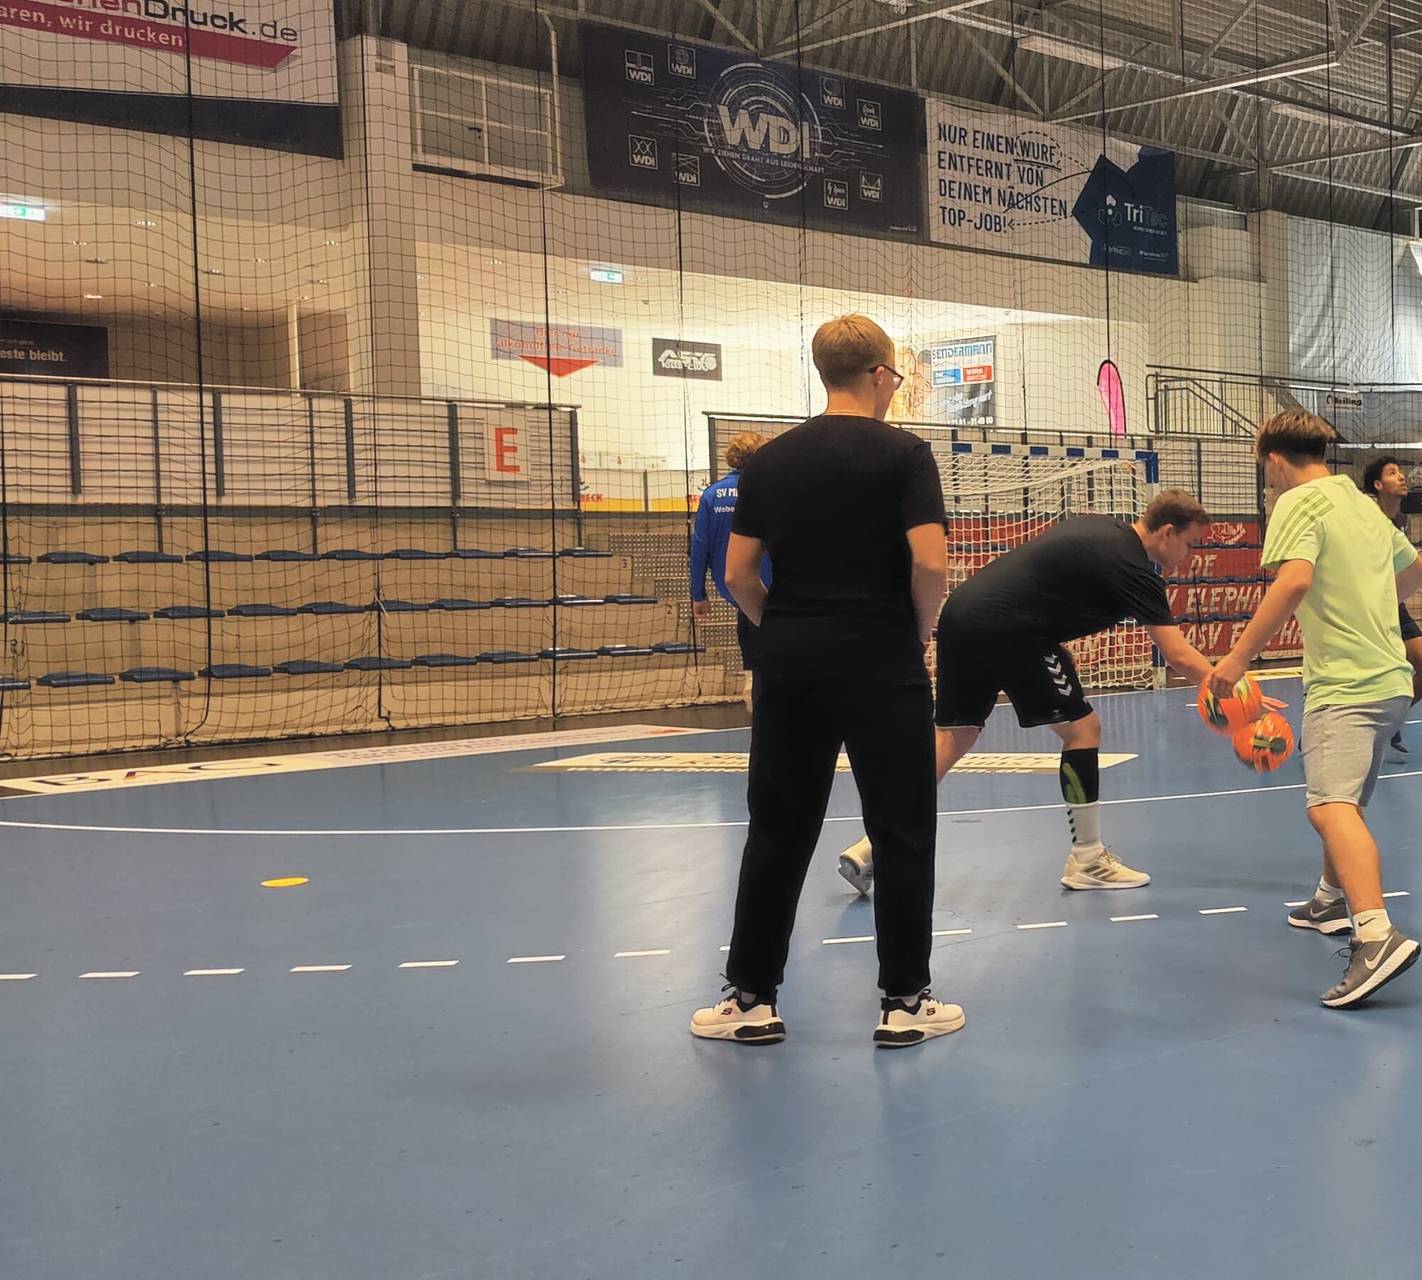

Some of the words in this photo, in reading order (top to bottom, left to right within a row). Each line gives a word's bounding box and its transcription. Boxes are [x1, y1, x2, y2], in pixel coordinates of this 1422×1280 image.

[60, 15, 93, 32] wir
[100, 19, 184, 48] drucken
[717, 103, 811, 159] WDI
[937, 123, 968, 146] NUR
[972, 130, 1016, 155] EINEN
[1018, 137, 1057, 163] WURF
[937, 151, 1014, 181] ENTFERNT
[1016, 164, 1045, 188] VON
[939, 178, 993, 206] DEINEM
[997, 185, 1068, 218] NÄCHSTEN
[938, 205, 1008, 234] TOP-JOB!
[494, 426, 521, 474] E
[716, 487, 727, 499] SV
